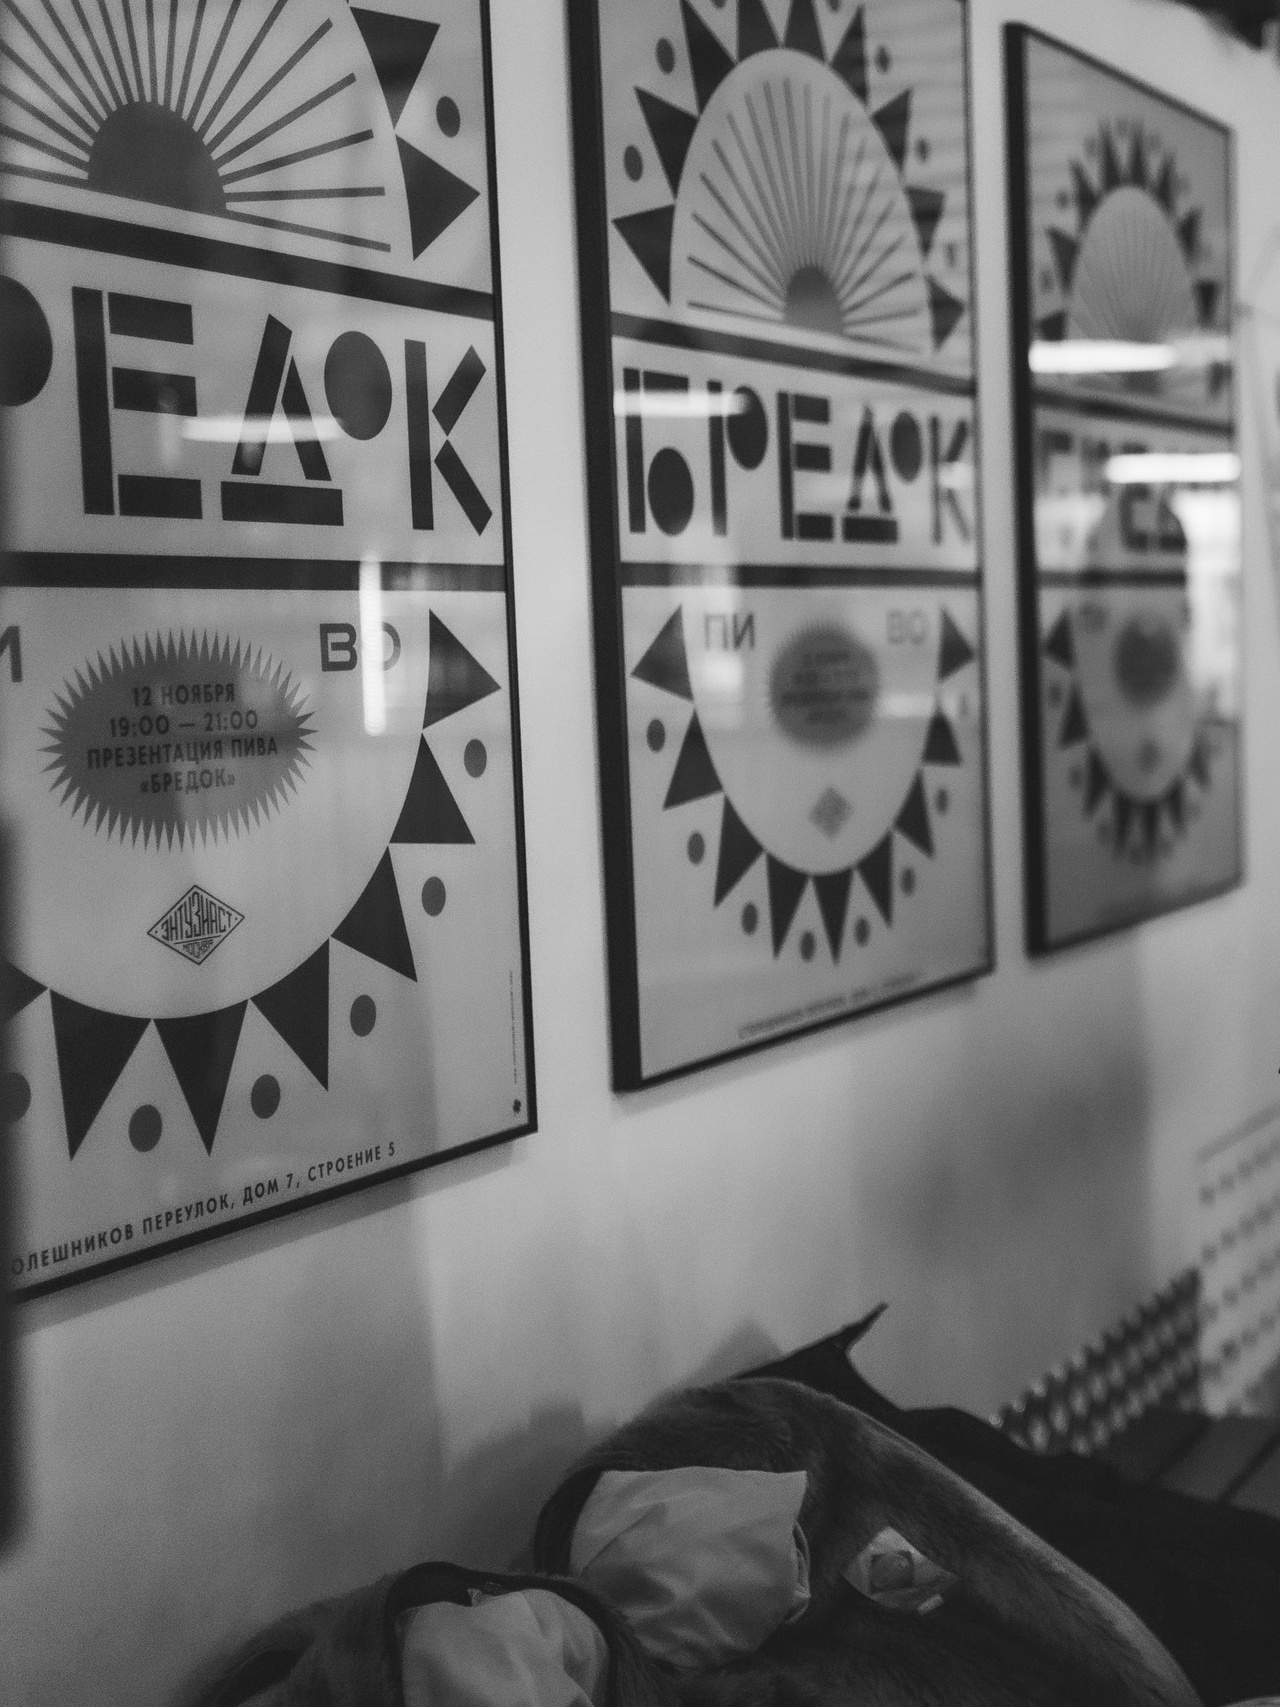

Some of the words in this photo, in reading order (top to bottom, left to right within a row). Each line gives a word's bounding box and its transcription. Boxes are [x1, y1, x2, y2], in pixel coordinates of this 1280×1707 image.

[623, 367, 971, 546] БРЕДОК
[705, 612, 755, 650] ПИ
[885, 608, 930, 647] ВО
[133, 686, 152, 707] 12
[162, 683, 235, 705] НОЯБРЯ
[110, 714, 169, 737] 19:00
[204, 709, 258, 732] 21:00
[87, 740, 223, 769] ПРЕЗЕНТАЦИЯ
[231, 736, 278, 759] ПИВА
[140, 768, 235, 795] «БРЕДОК»
[142, 1193, 235, 1235] ПЕРЕУЛОК,
[242, 1178, 279, 1206] ДОМ
[286, 1173, 300, 1189] 7,
[308, 1146, 381, 1182] СТРОЕНИЕ
[388, 1141, 395, 1157] 5
